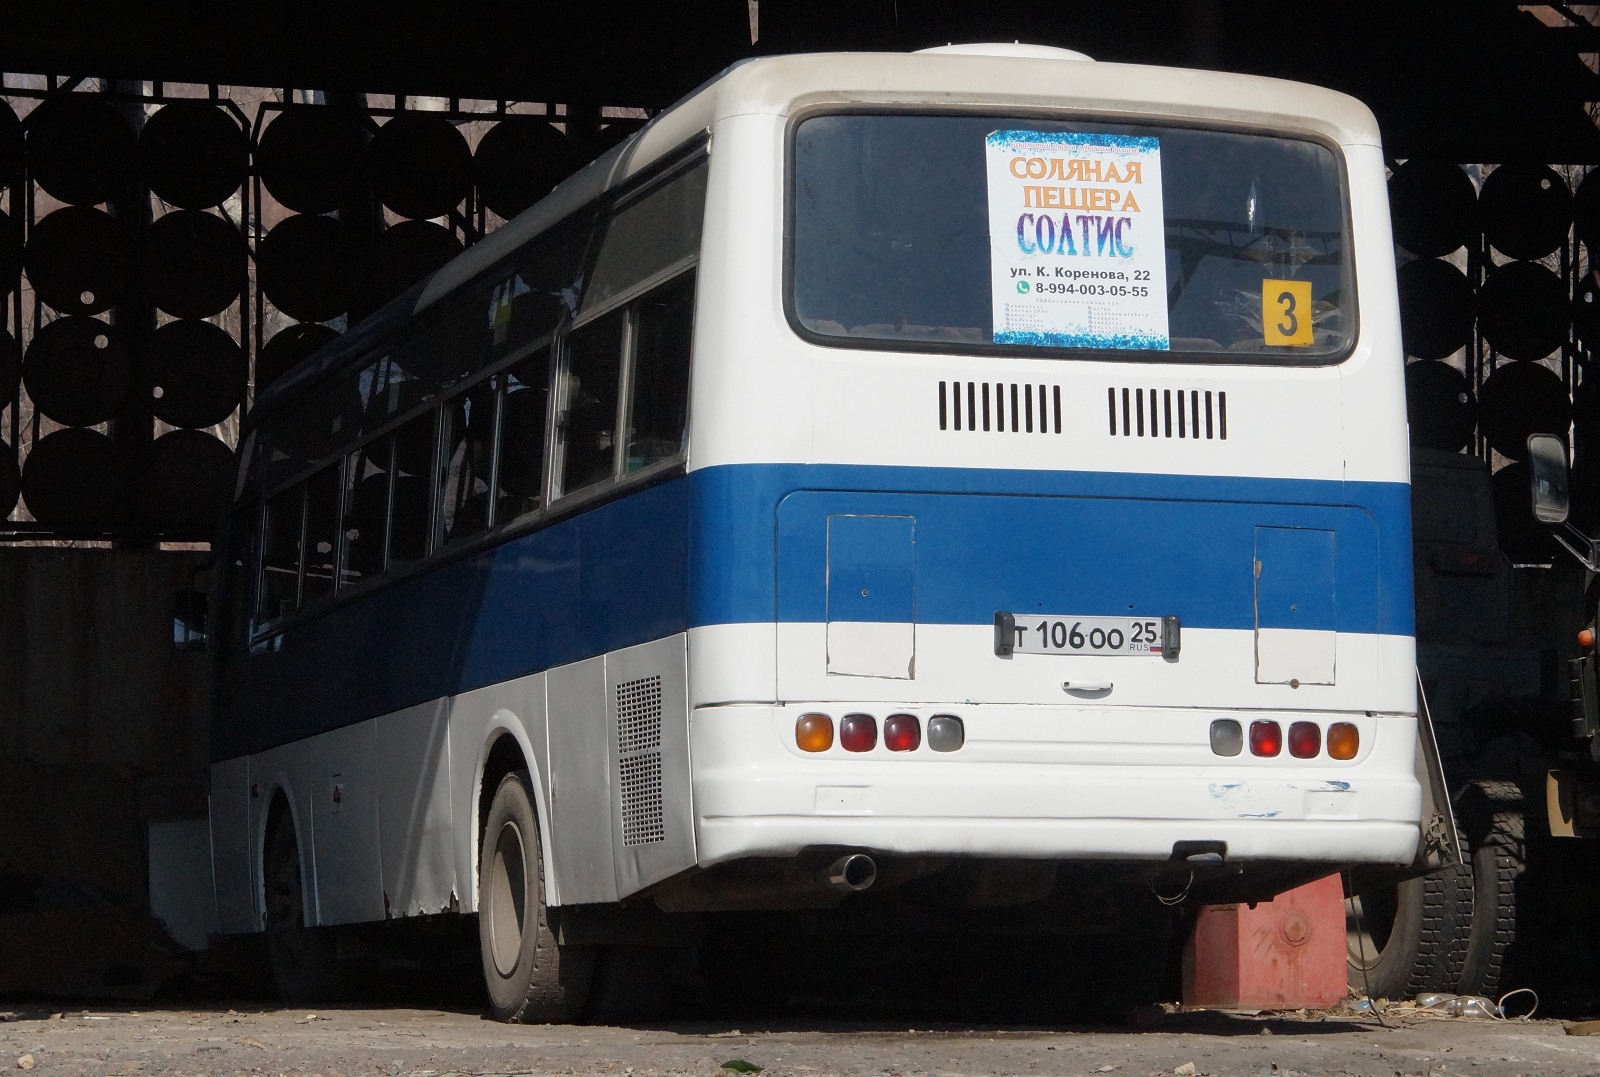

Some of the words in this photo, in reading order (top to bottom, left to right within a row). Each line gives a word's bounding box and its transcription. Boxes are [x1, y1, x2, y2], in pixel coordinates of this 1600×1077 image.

[1009, 156, 1142, 184] СОЛЯНАЯ
[1022, 185, 1141, 213] ПЕЩЕРА
[1016, 212, 1133, 258] СОЛТИС
[1010, 267, 1031, 278] ул.
[1036, 266, 1050, 277] К.
[1055, 267, 1129, 282] Коренова,
[1133, 270, 1151, 281] 22
[1035, 282, 1149, 297] 8-994-003-05-55
[1277, 291, 1297, 337] 3
[1130, 622, 1157, 643] 25
[1129, 643, 1149, 651] RUS
